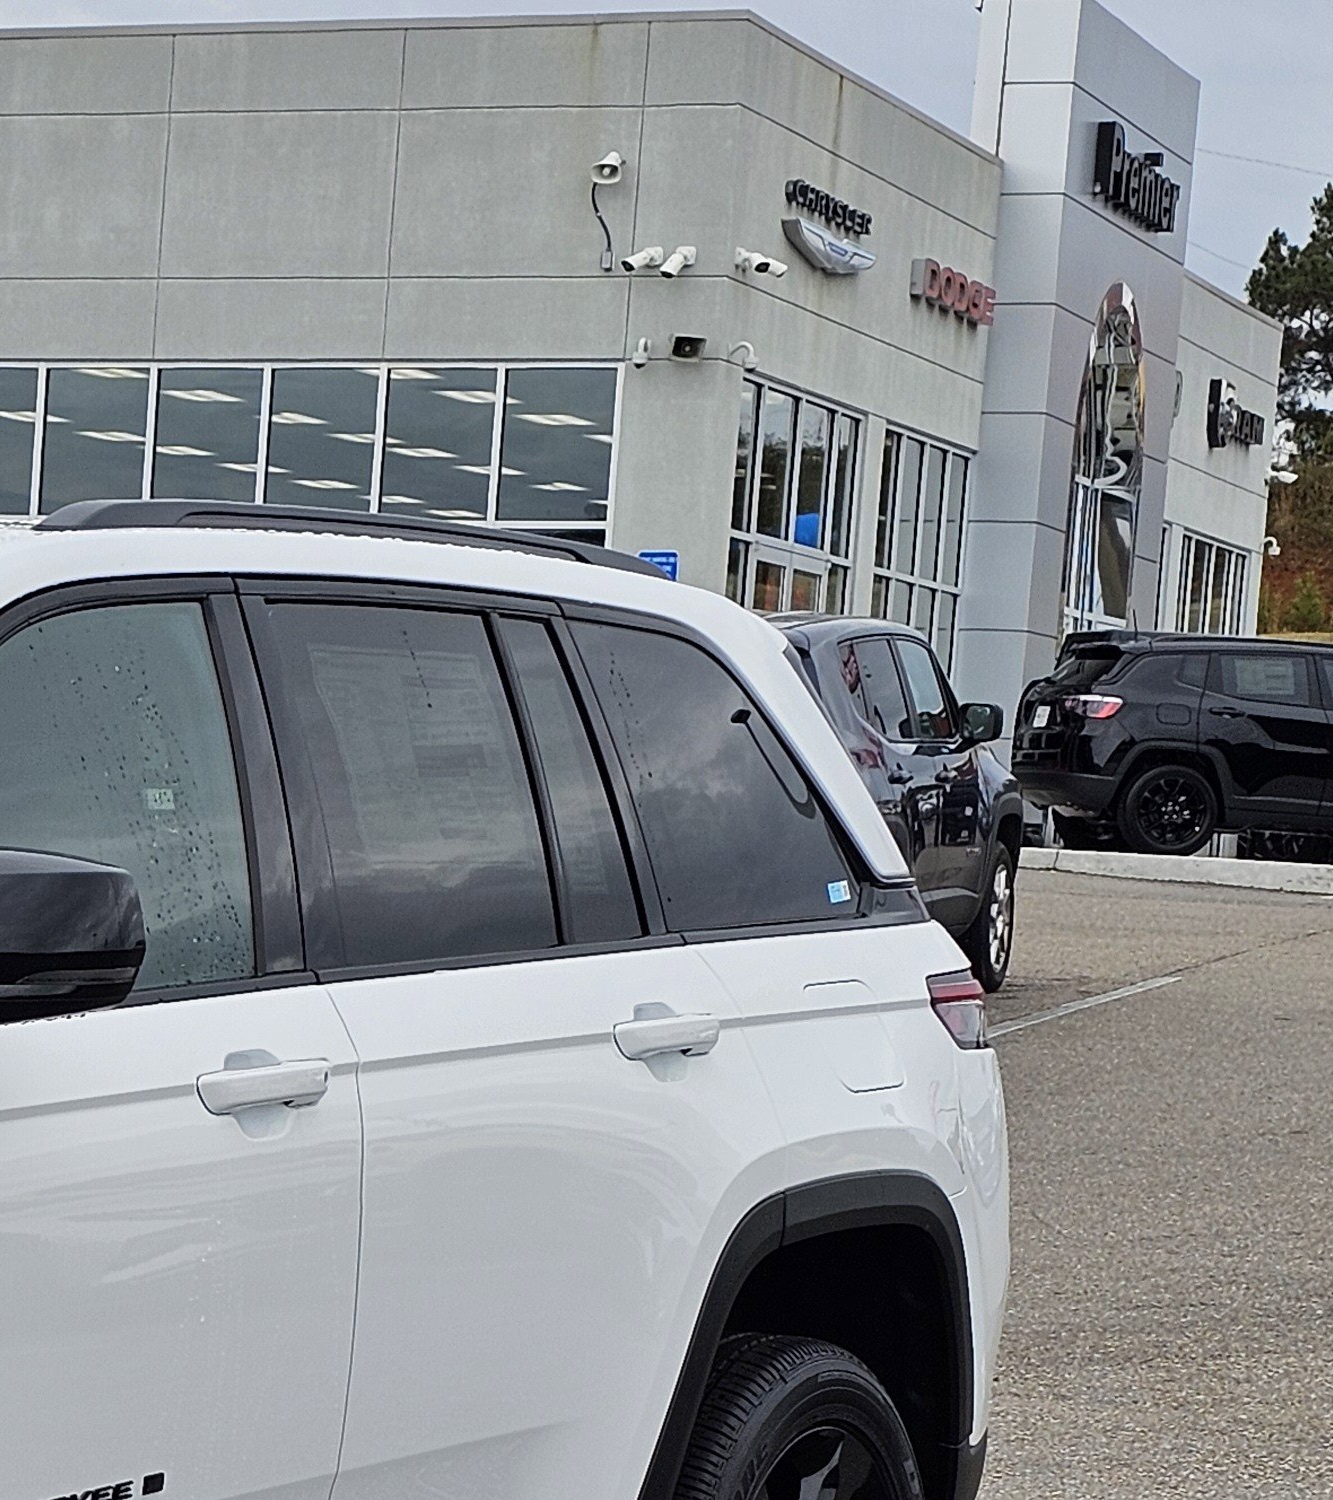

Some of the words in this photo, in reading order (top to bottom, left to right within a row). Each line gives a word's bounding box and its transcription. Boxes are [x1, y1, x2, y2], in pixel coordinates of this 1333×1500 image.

[785, 179, 873, 236] CHRYSLER
[1094, 120, 1180, 232] Premier
[910, 258, 996, 326] DODGE
